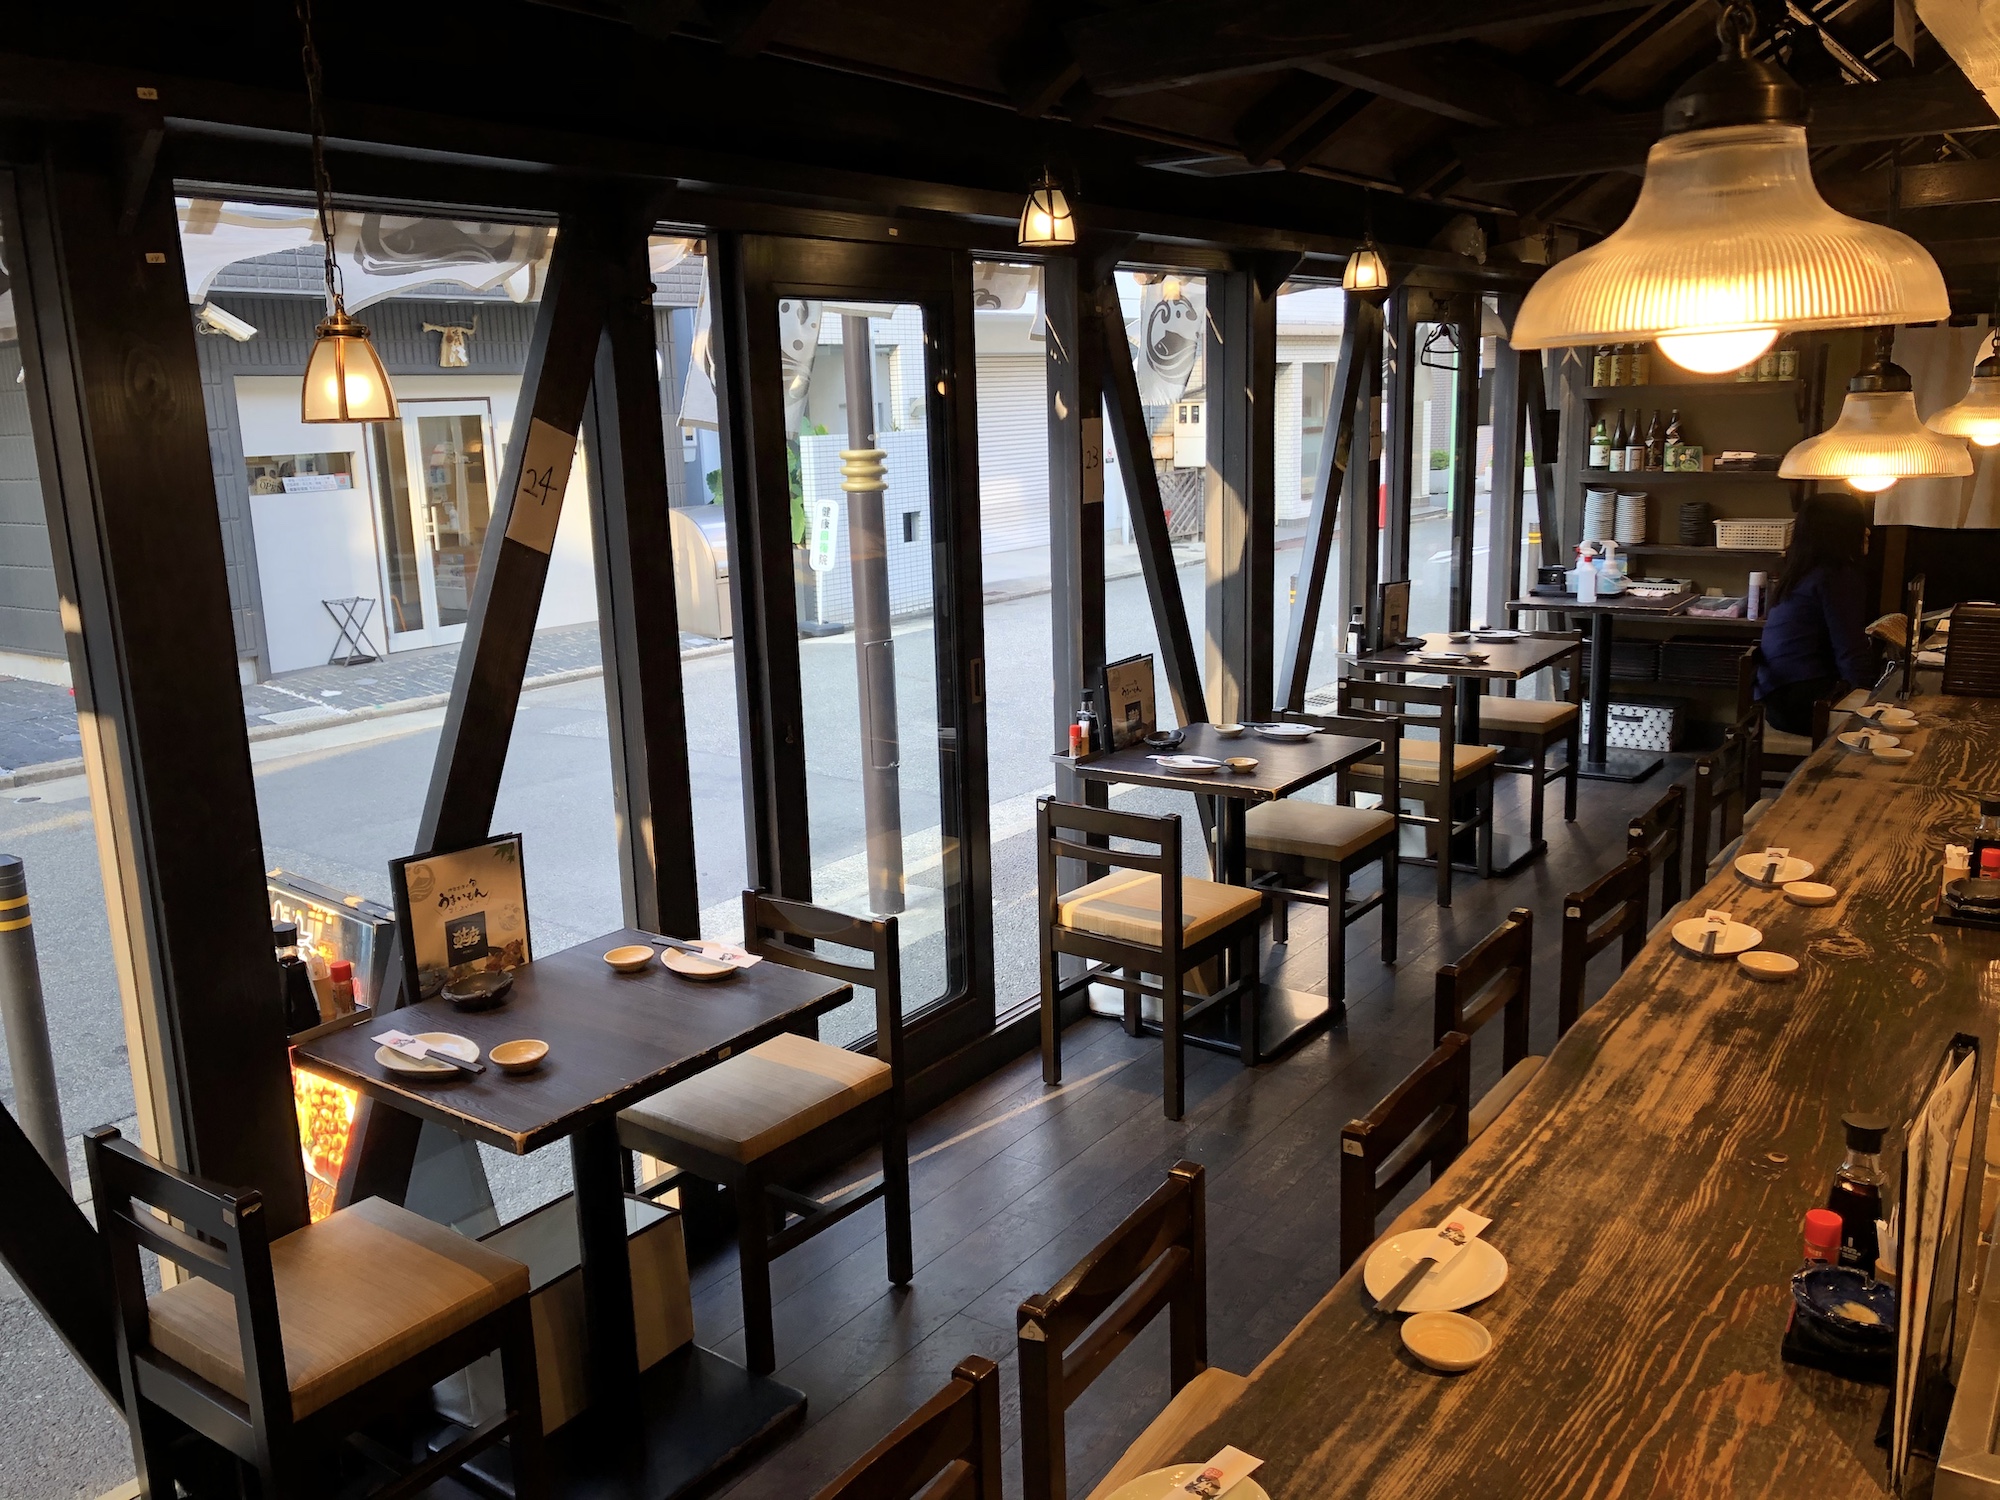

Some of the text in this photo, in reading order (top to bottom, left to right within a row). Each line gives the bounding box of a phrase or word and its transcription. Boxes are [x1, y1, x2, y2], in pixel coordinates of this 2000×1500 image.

[1085, 445, 1099, 469] 23
[522, 465, 558, 506] 24
[438, 887, 489, 911] うまいもん
[1027, 1324, 1036, 1339] 5
